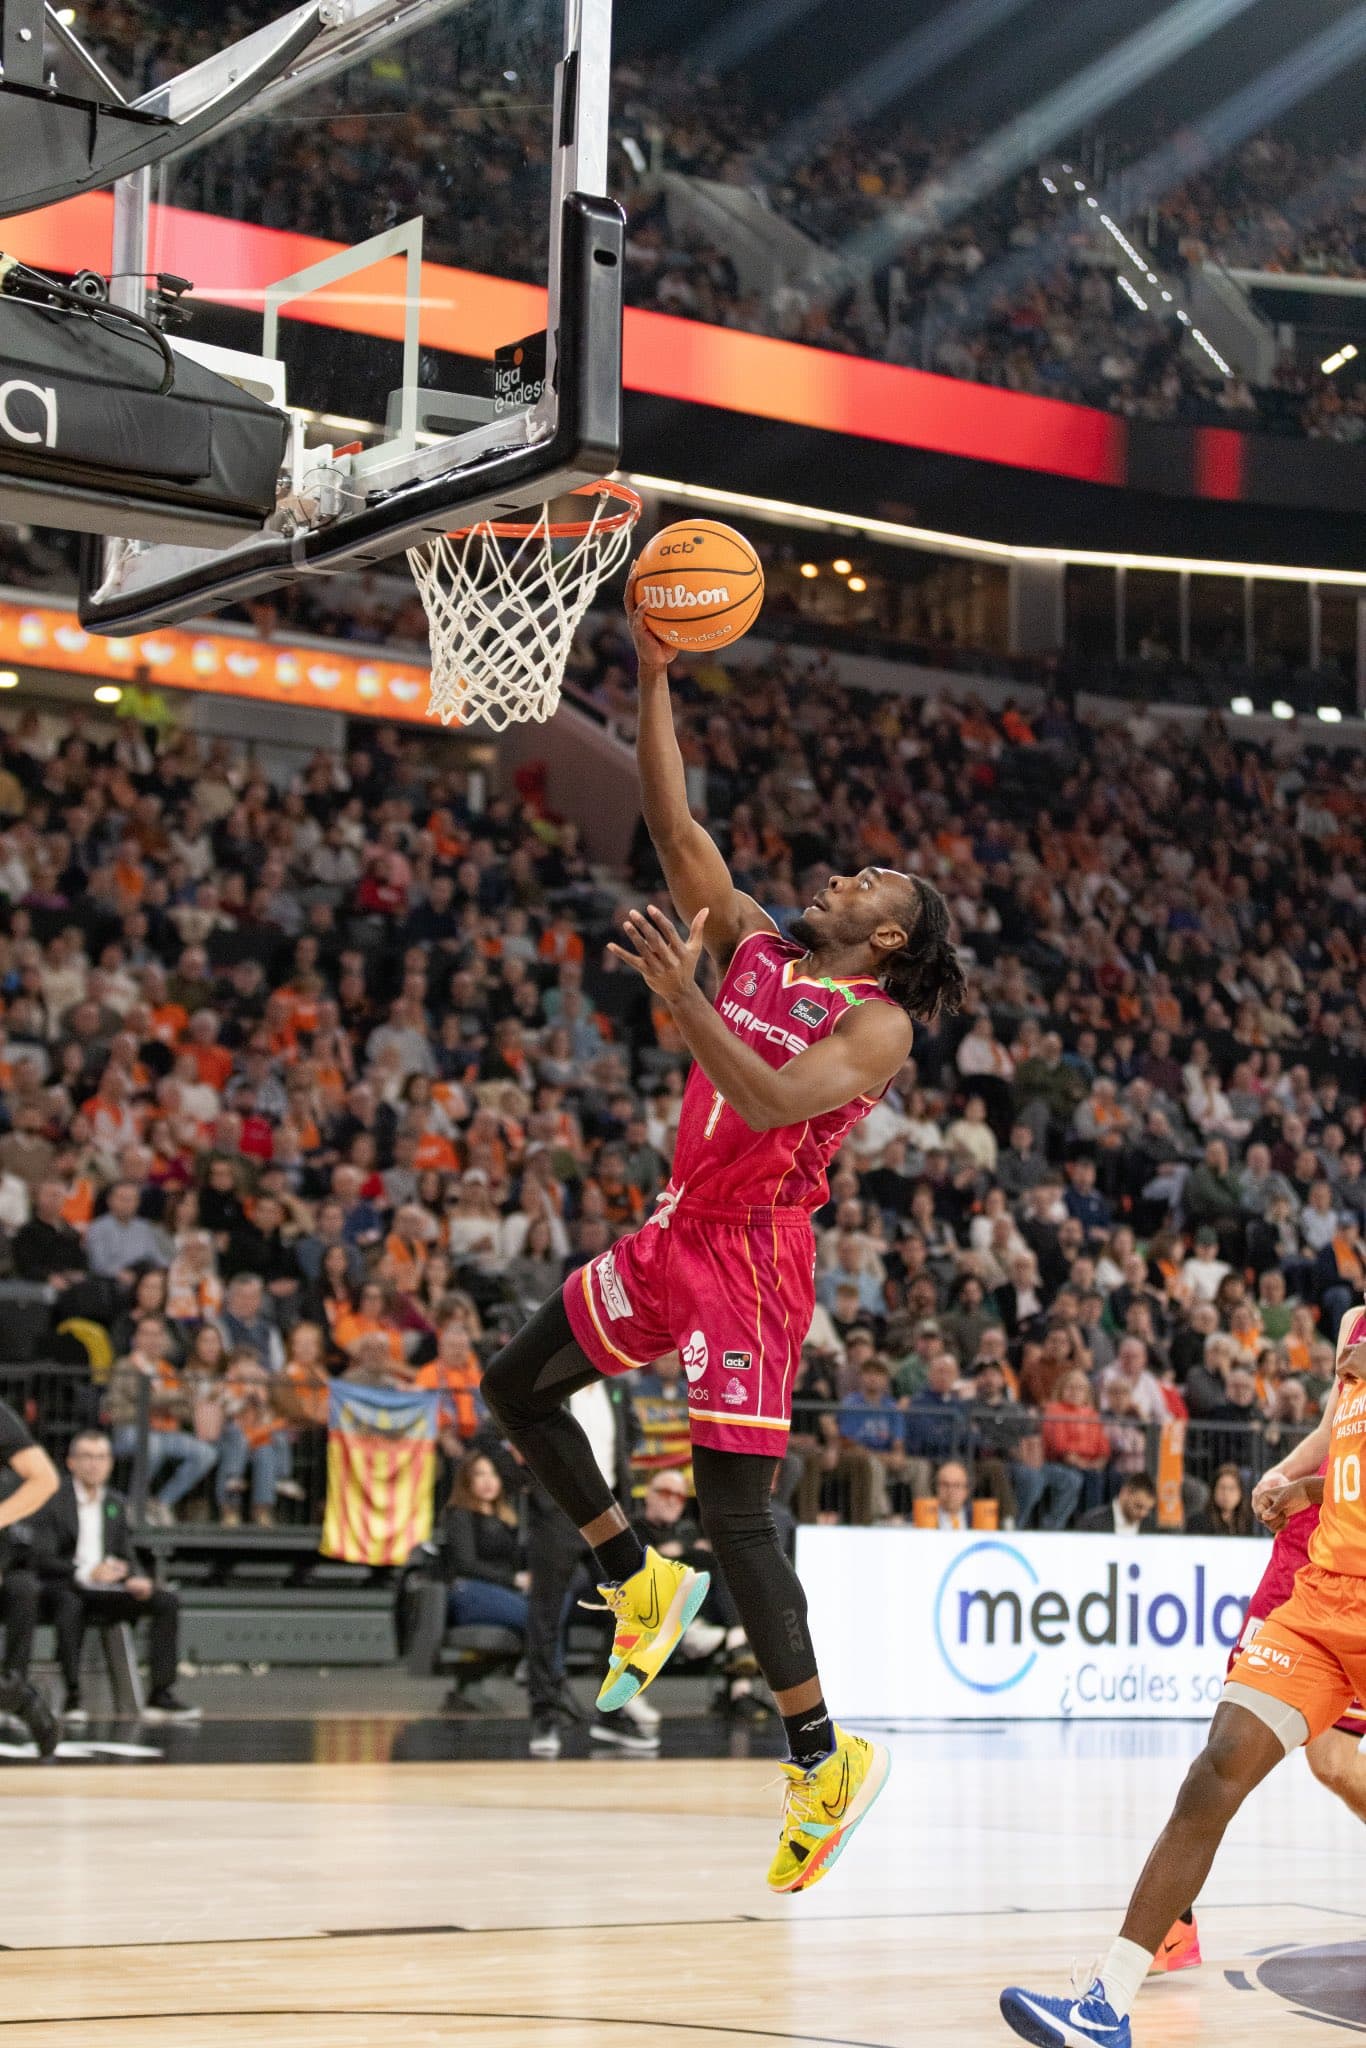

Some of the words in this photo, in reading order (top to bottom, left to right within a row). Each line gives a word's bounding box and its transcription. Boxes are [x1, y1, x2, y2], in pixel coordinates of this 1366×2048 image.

[495, 367, 520, 392] liga
[660, 541, 695, 556] acb
[643, 585, 729, 609] Wilson
[726, 1358, 745, 1367] acb
[1333, 1453, 1360, 1504] 10
[1246, 1644, 1291, 1669] ULEVA
[1060, 1663, 1179, 1714] ¿Cuáles
